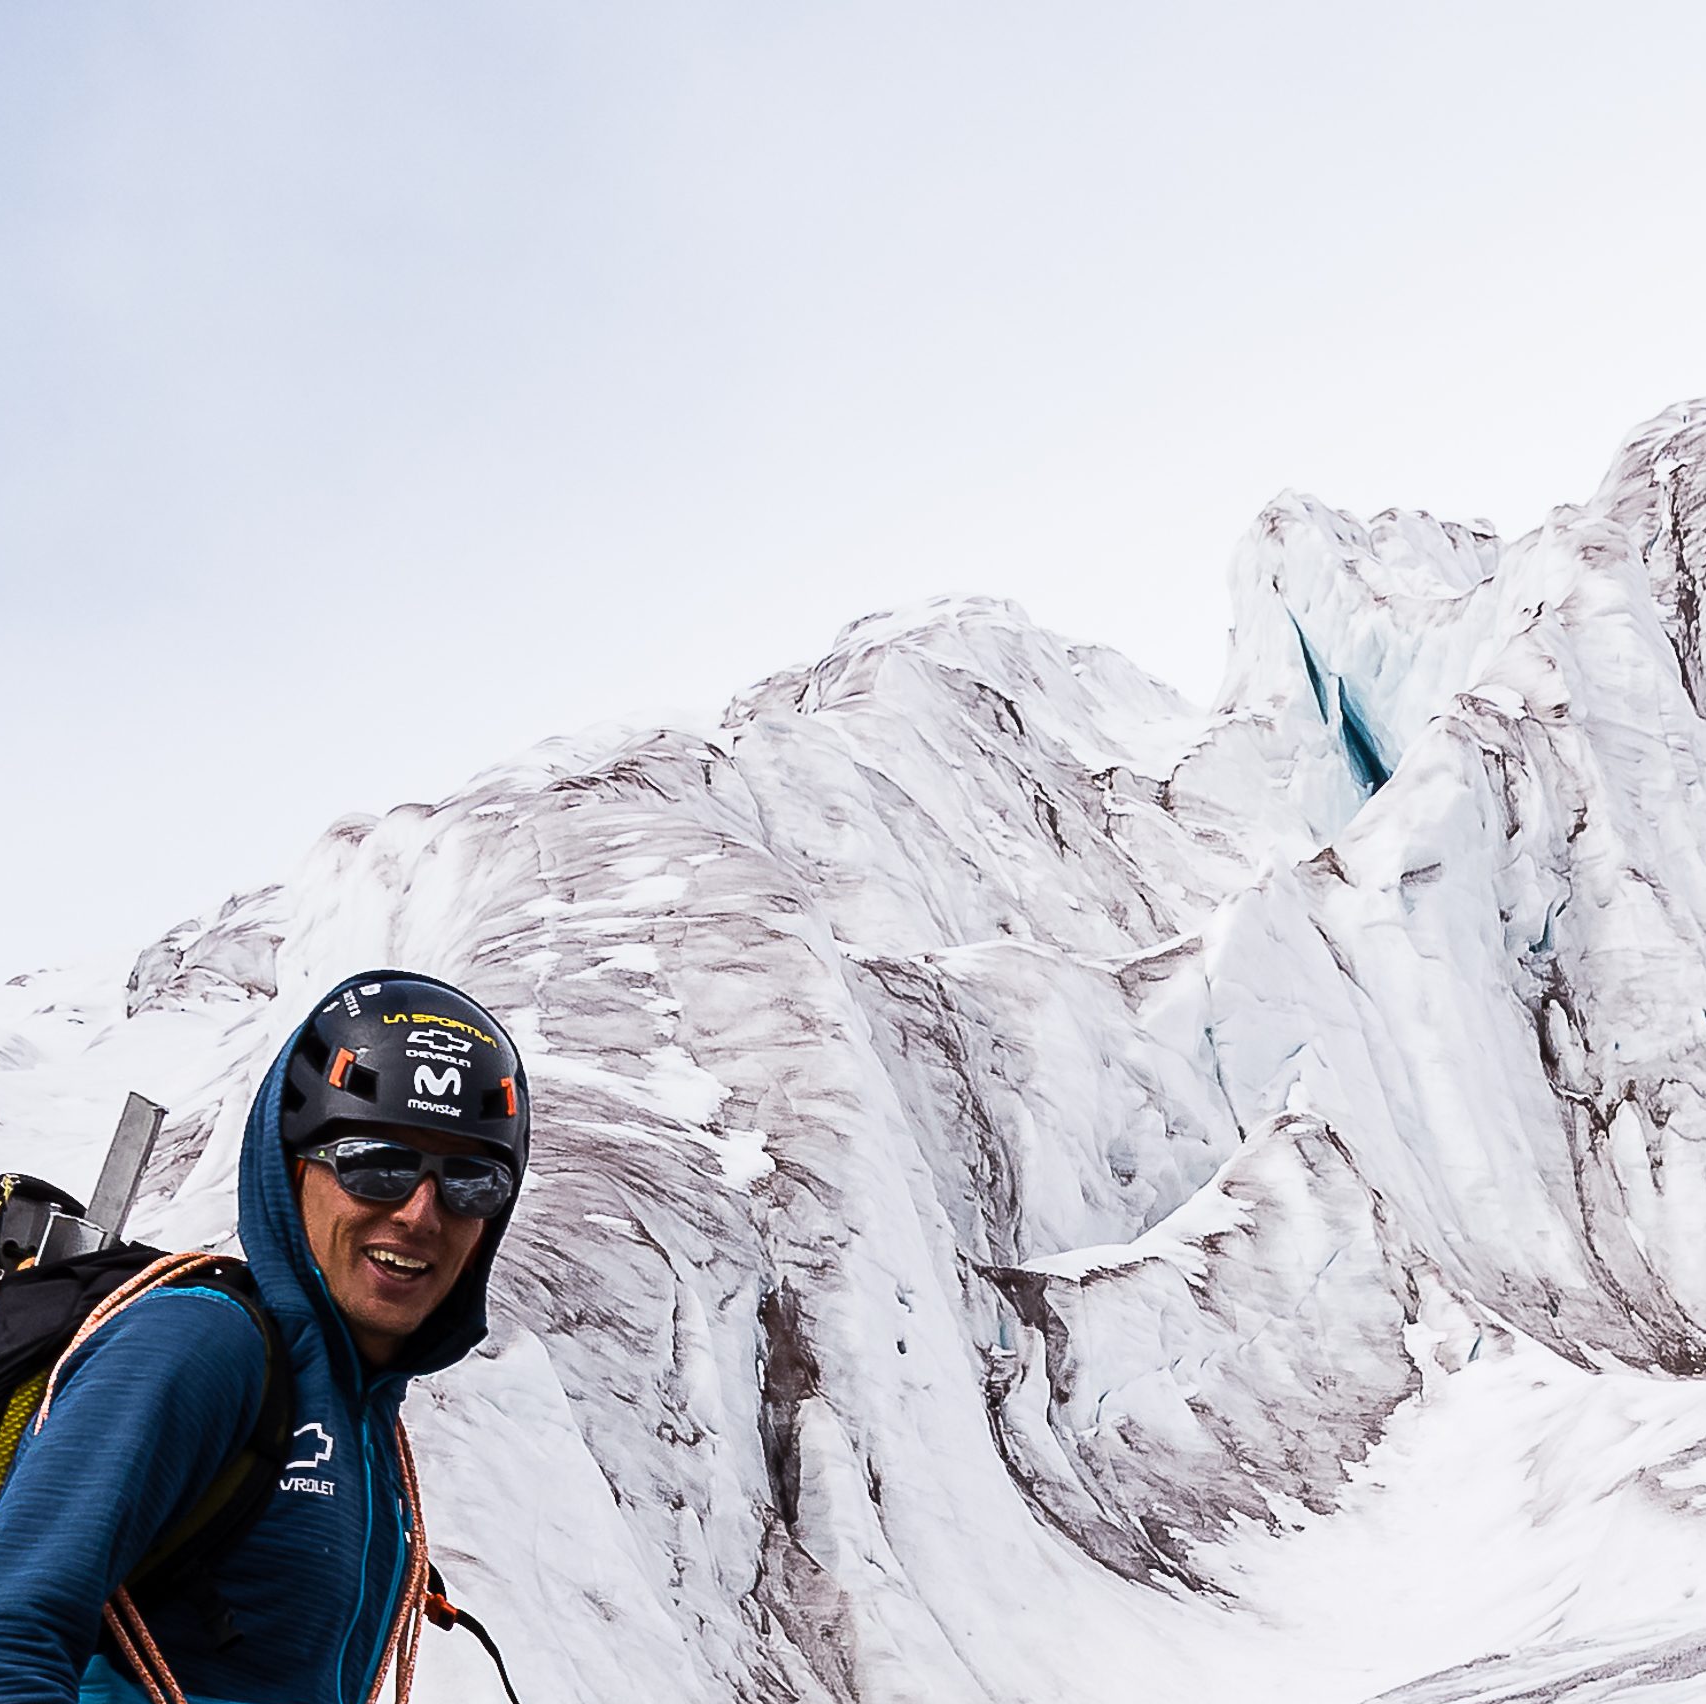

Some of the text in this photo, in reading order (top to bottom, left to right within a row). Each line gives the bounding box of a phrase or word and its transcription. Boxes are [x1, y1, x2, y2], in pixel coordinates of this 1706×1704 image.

[383, 1013, 408, 1024] LA
[407, 1098, 462, 1117] movistar
[279, 1477, 335, 1495] VROLET
